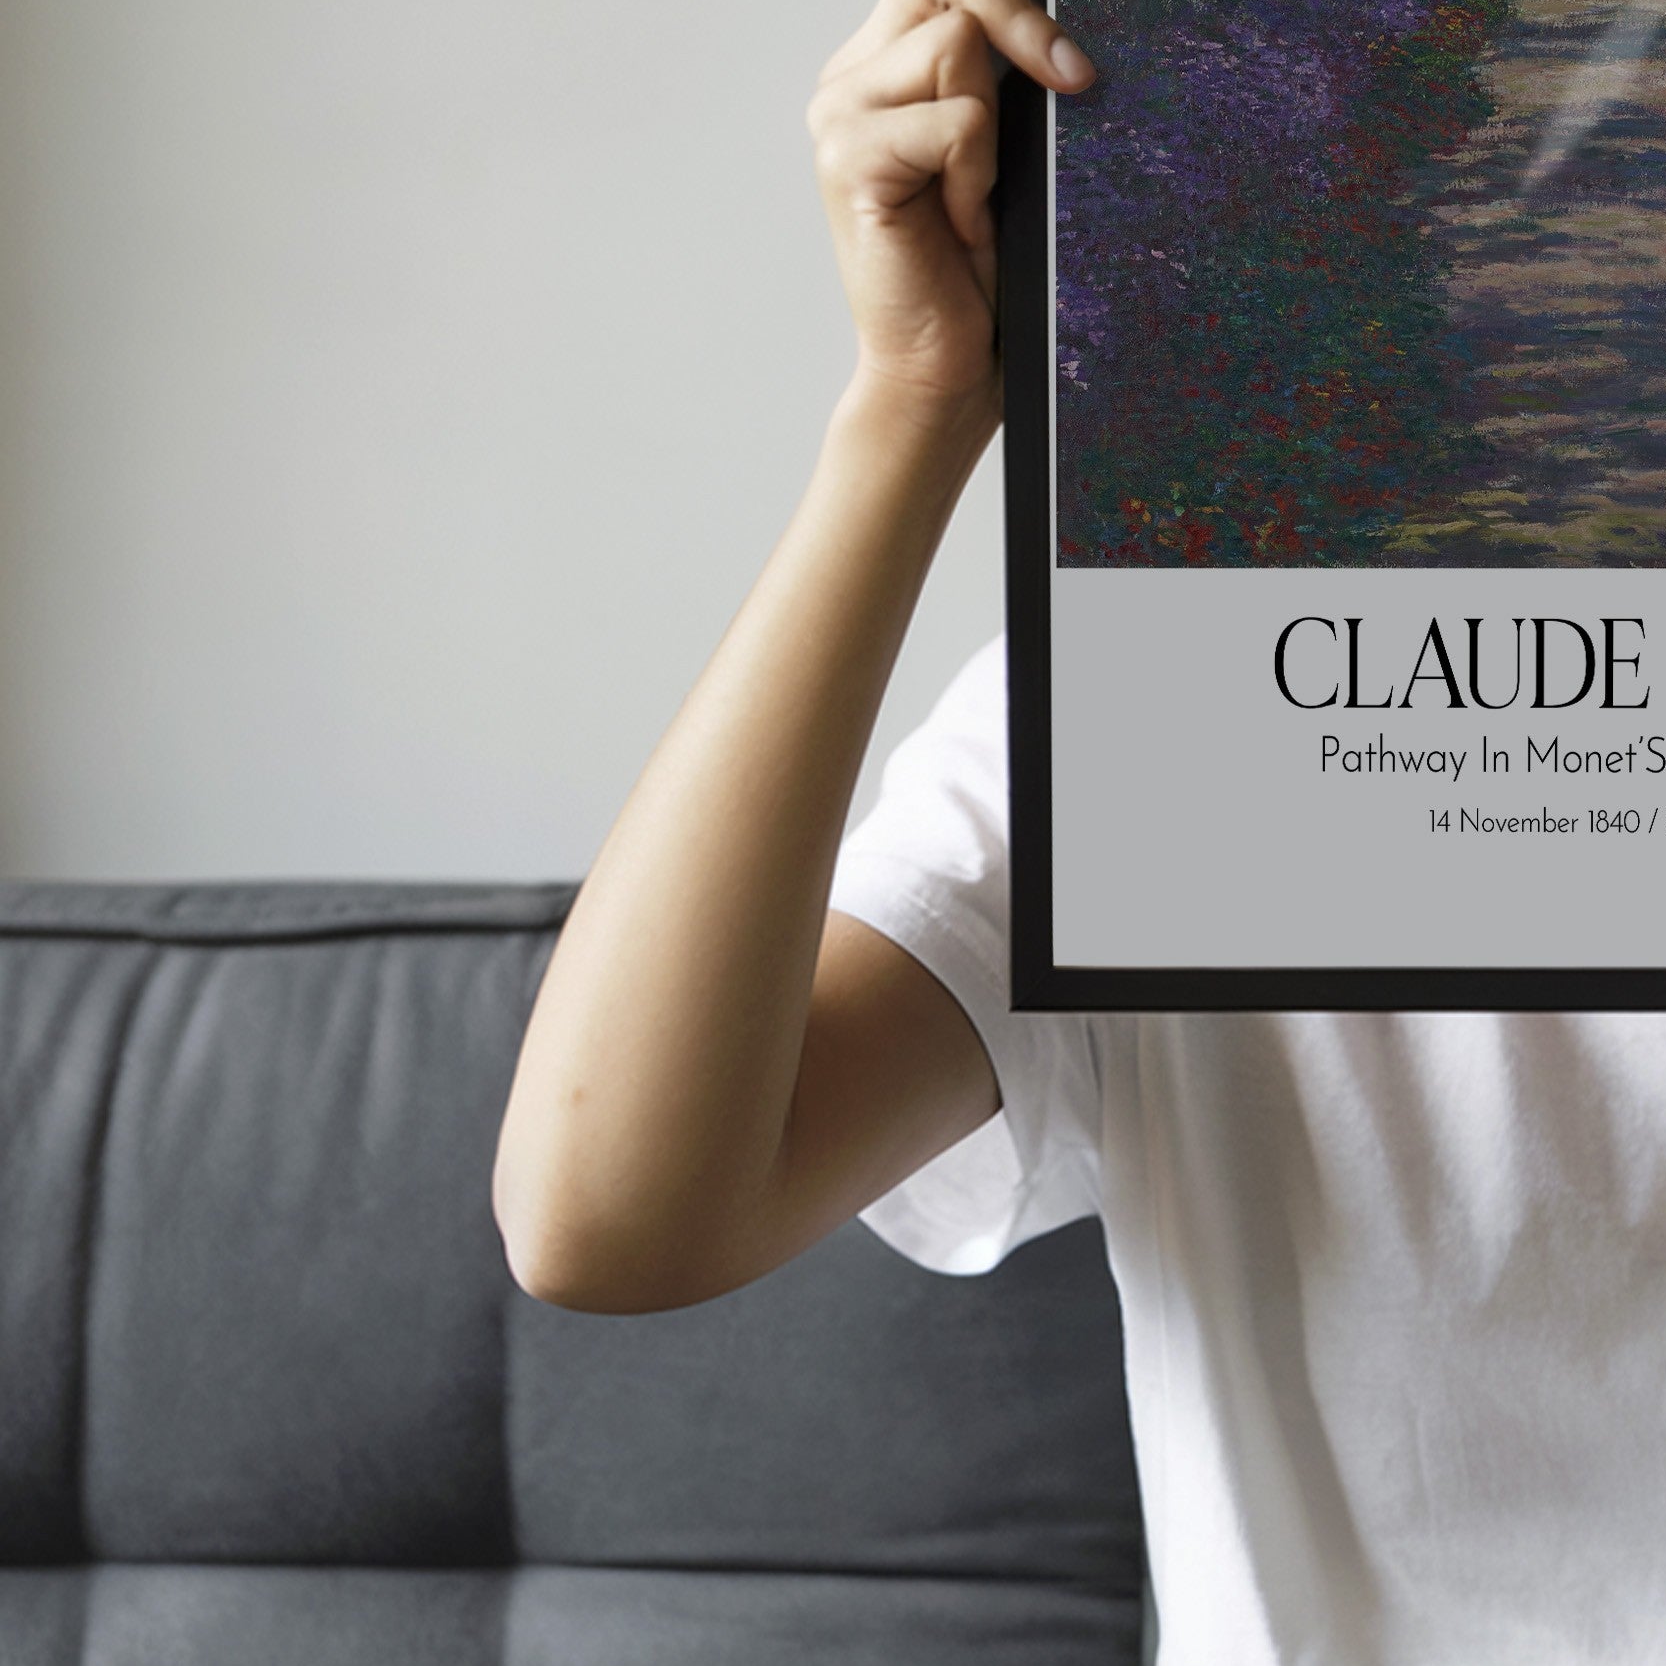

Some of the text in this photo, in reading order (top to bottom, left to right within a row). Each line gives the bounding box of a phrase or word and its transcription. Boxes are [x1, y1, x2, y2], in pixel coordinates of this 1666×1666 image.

[1273, 615, 1651, 711] CLAUDE
[1320, 733, 1468, 783] Pathway
[1481, 734, 1509, 774] In
[1526, 735, 1666, 775] Monet'S
[1428, 808, 1452, 834] 14
[1459, 806, 1580, 835] November
[1586, 808, 1641, 835] 1840
[1648, 806, 1659, 835] /
